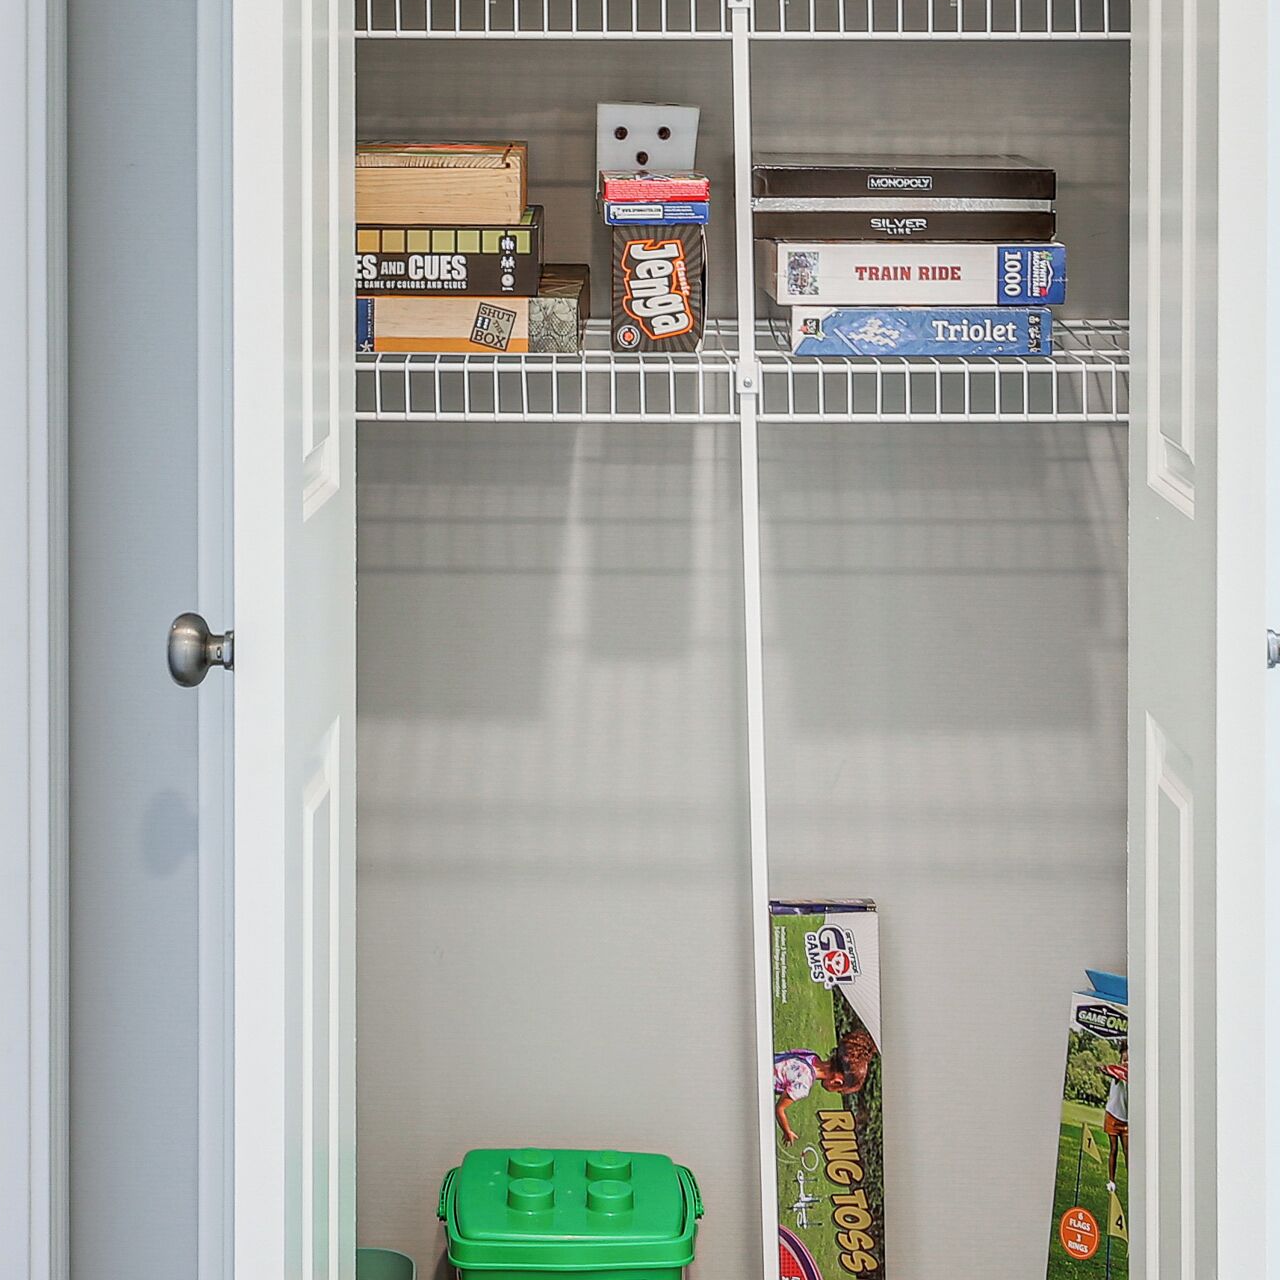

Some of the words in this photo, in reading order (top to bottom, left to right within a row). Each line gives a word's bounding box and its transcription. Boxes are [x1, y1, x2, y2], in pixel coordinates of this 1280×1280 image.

[870, 178, 930, 188] MONOPOLY
[870, 218, 927, 228] SILVER
[380, 261, 406, 275] AND
[408, 254, 467, 280] CUES
[854, 266, 911, 281] TRAIN
[918, 266, 961, 281] RIDE
[1004, 251, 1021, 296] 1000
[1032, 250, 1041, 297] MOUNTAIN
[1038, 260, 1048, 287] WHITE
[363, 280, 385, 289] GAME
[385, 280, 396, 289] OF
[396, 280, 426, 289] COLORS
[426, 280, 442, 289] AND
[443, 280, 467, 289] CLUES
[630, 243, 689, 336] Jenga
[480, 306, 514, 323] SHUT
[474, 329, 507, 348] BOX
[931, 319, 1018, 342] Triolet
[806, 934, 825, 980] GAMES
[1078, 1010, 1107, 1025] GAME
[818, 1110, 864, 1185] RING
[1086, 1137, 1092, 1149] 1
[1069, 1217, 1091, 1232] FLAGS
[1078, 1212, 1084, 1221] 6
[1115, 1215, 1124, 1231] 4
[831, 1188, 879, 1273] TOSS
